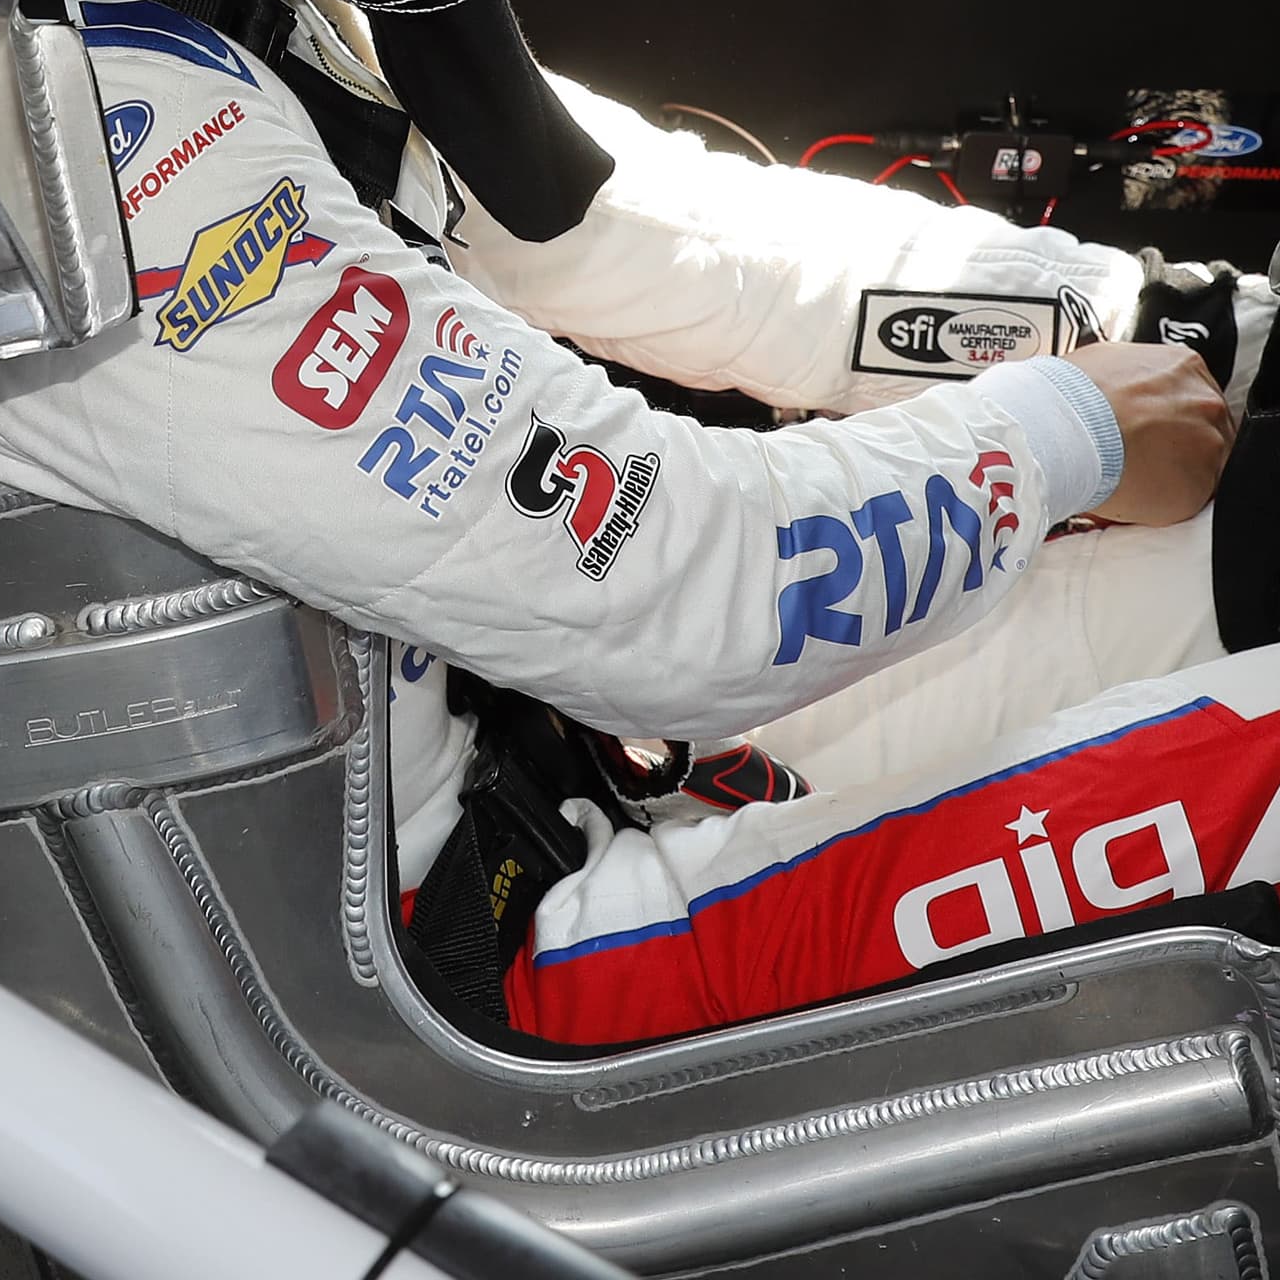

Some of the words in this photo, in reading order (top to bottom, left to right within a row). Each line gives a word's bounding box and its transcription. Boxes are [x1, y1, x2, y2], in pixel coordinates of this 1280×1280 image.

[120, 100, 247, 221] RFORMANCE
[166, 185, 300, 343] SUNOCO
[298, 284, 393, 410] SEM
[890, 314, 935, 352] sfi
[947, 323, 1032, 339] MANUFACTURER
[959, 336, 1017, 352] CERTIFIED
[357, 354, 488, 500] RTA
[419, 347, 523, 521] rtatel.com
[581, 459, 655, 577] safety-kleen
[771, 473, 984, 667] RTA
